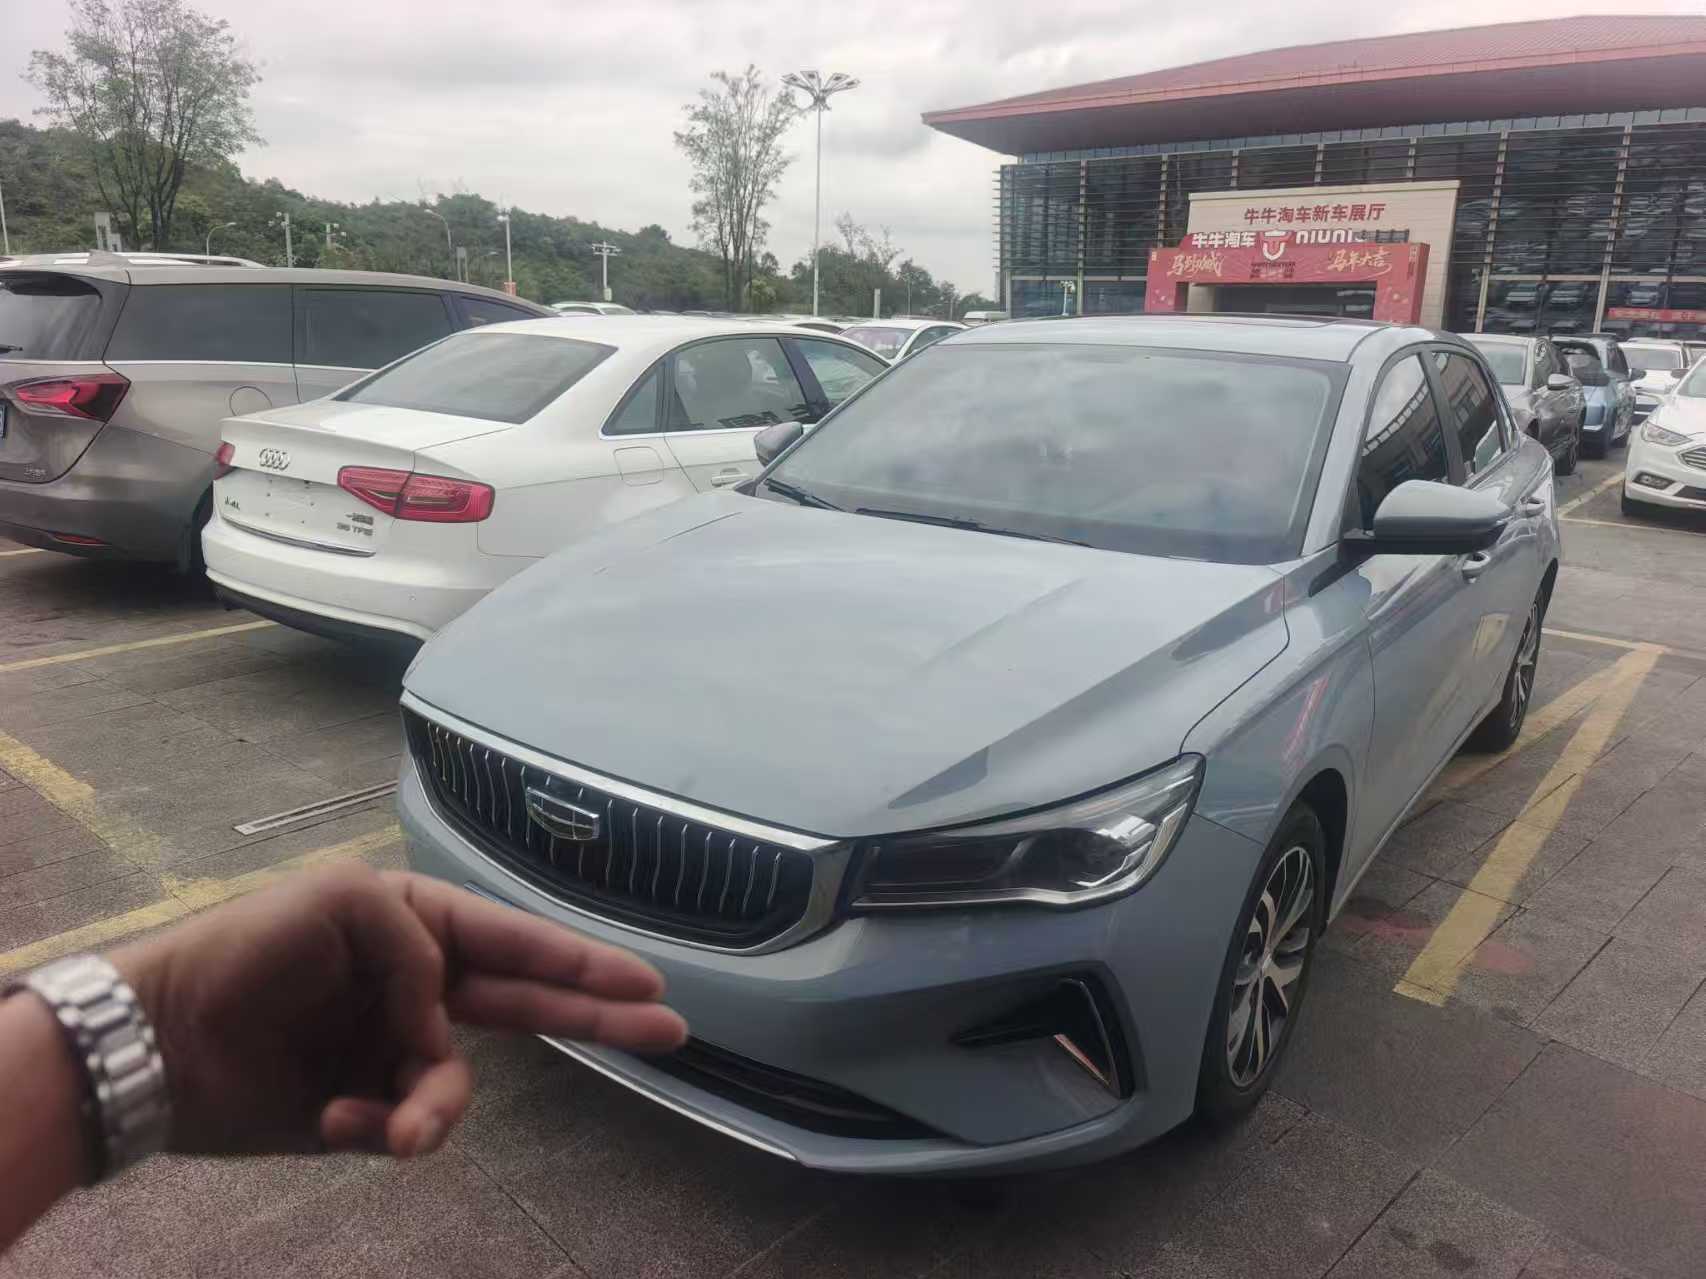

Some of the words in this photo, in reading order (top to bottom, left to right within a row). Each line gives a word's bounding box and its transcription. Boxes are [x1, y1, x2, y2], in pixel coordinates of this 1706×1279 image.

[1243, 203, 1387, 225] 牛牛淘车新车展厅
[1191, 231, 1257, 249] 牛牛淘车
[1328, 246, 1393, 277] 马年大吉
